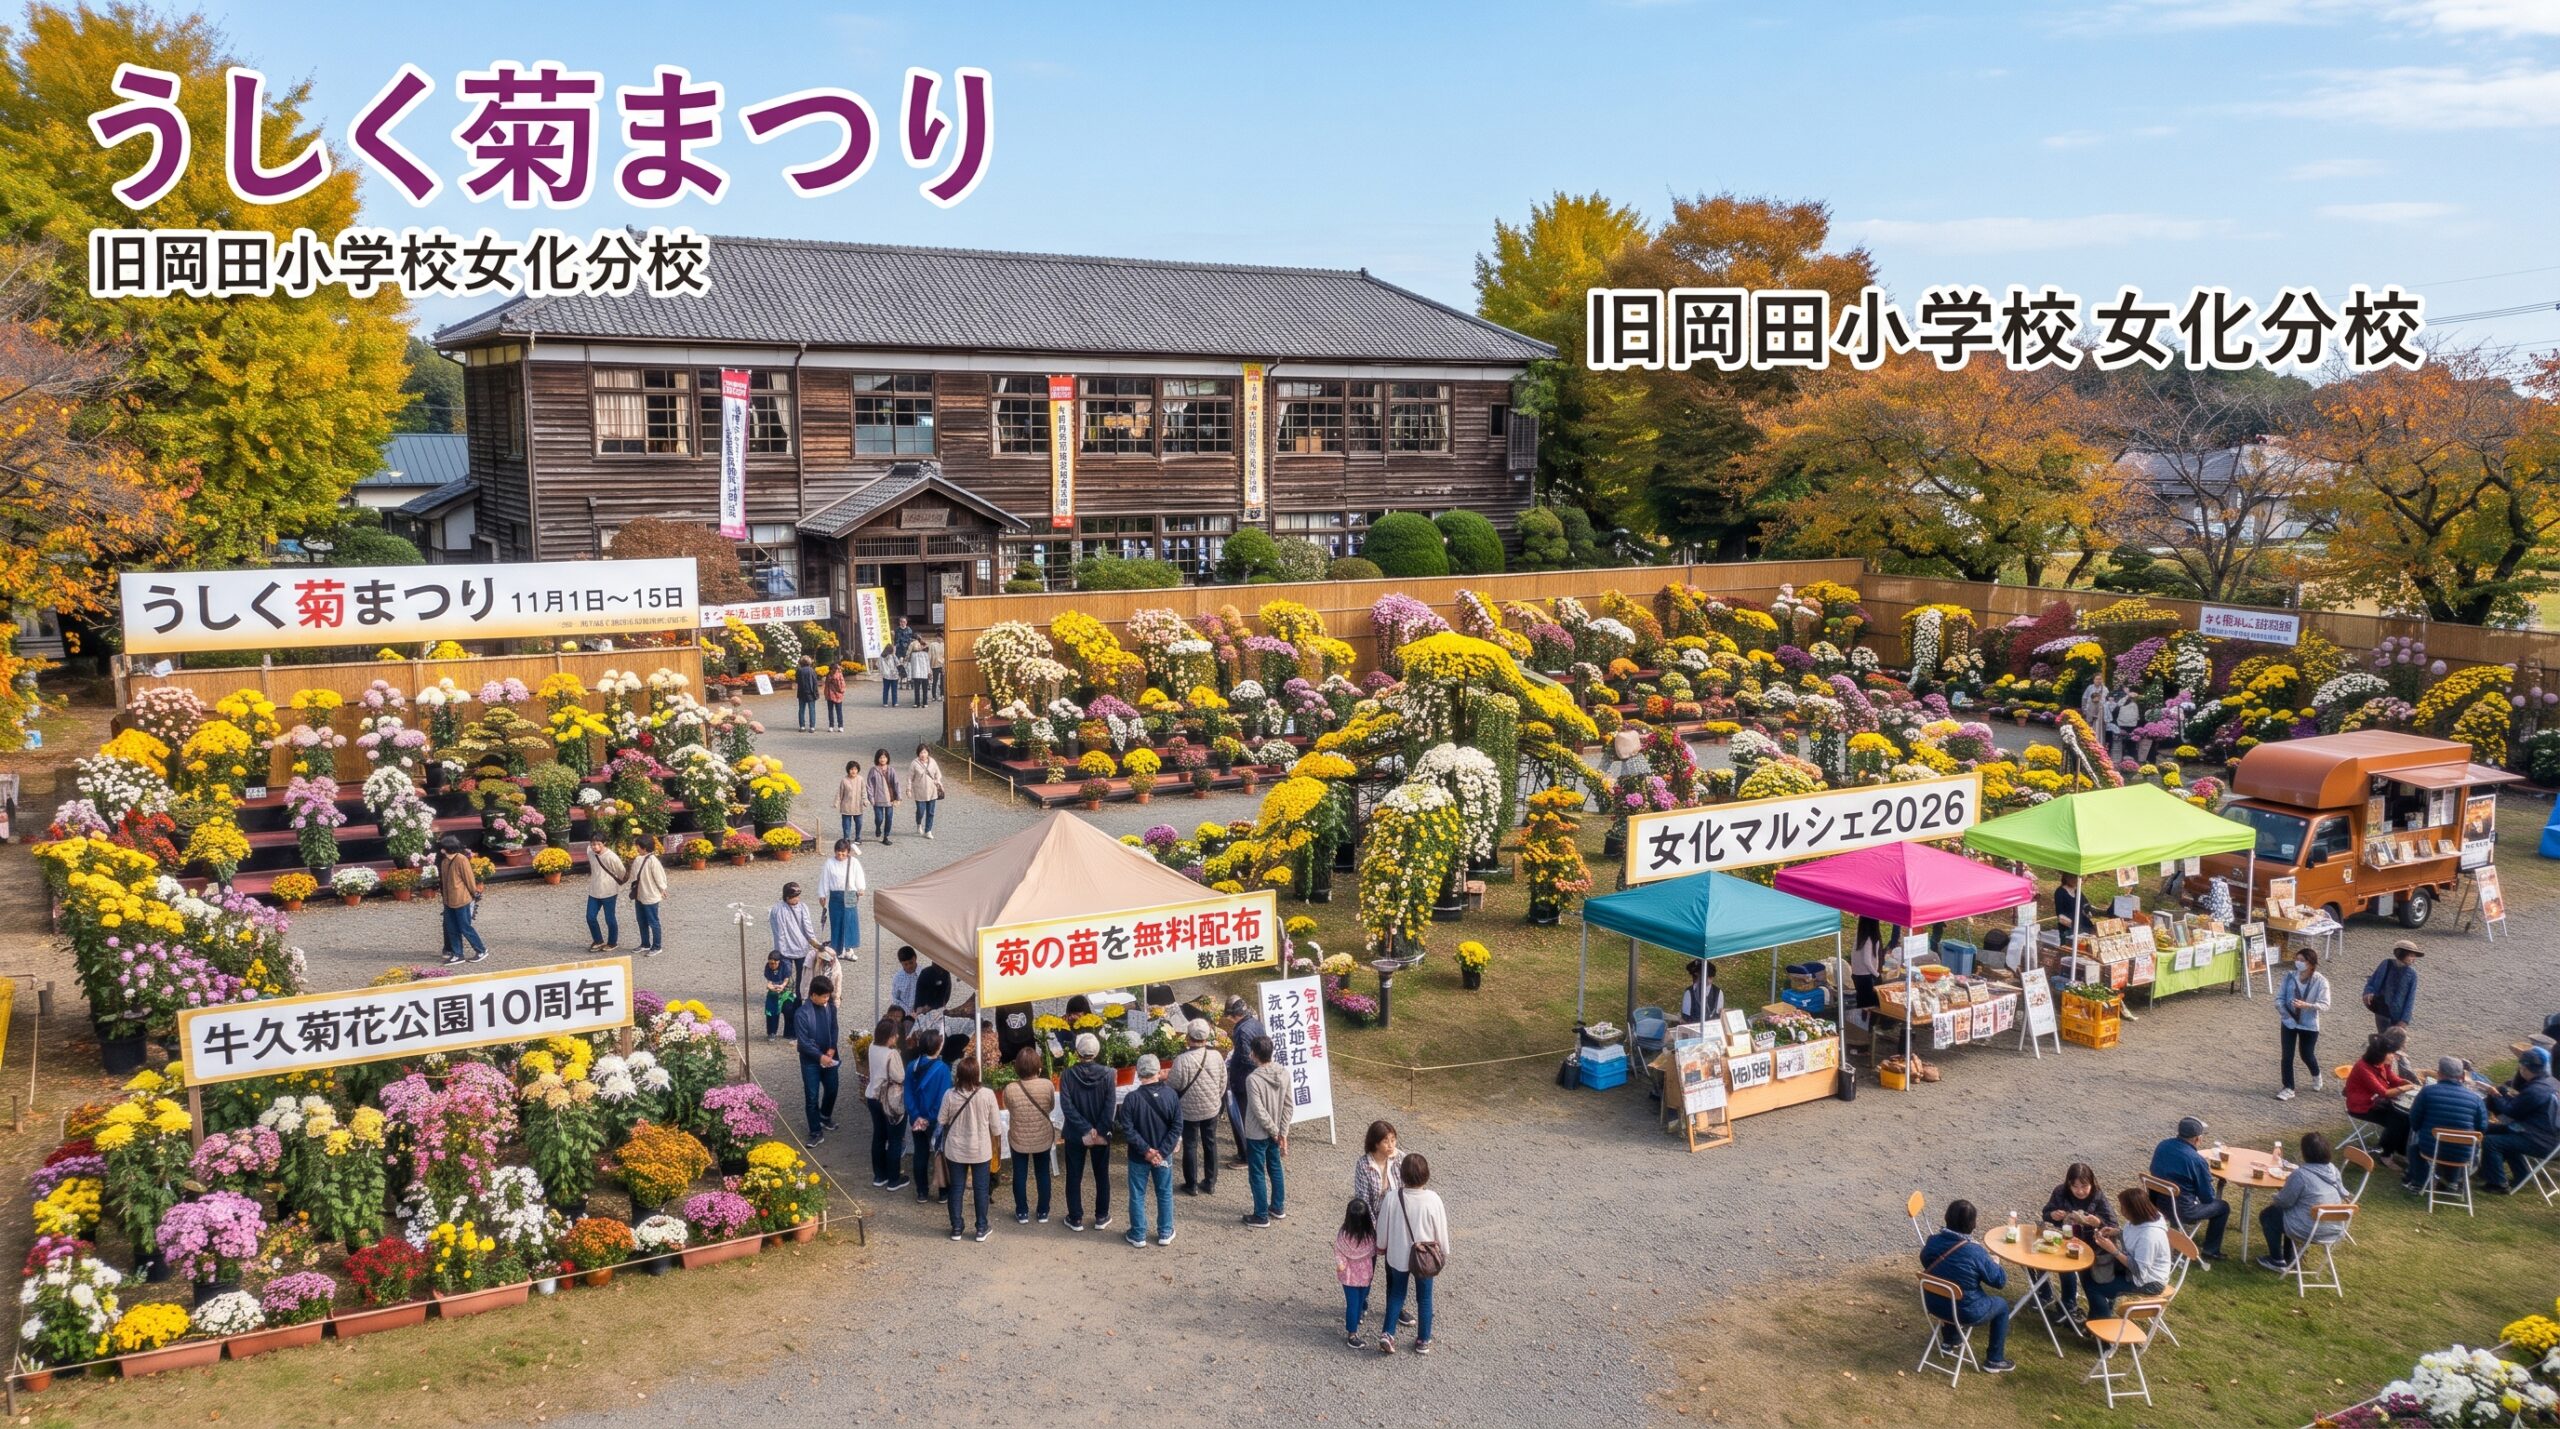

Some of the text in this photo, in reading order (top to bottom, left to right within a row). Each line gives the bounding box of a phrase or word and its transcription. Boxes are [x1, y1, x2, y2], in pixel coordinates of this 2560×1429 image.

[144, 577, 494, 634] うしく菊まつり
[1648, 789, 1965, 871] 女化マルシェ2026
[996, 907, 1262, 977] 菊の苗を無料配布
[1197, 944, 1266, 971] 数量限定
[203, 977, 615, 1066] 牛久菊花公園10周年
